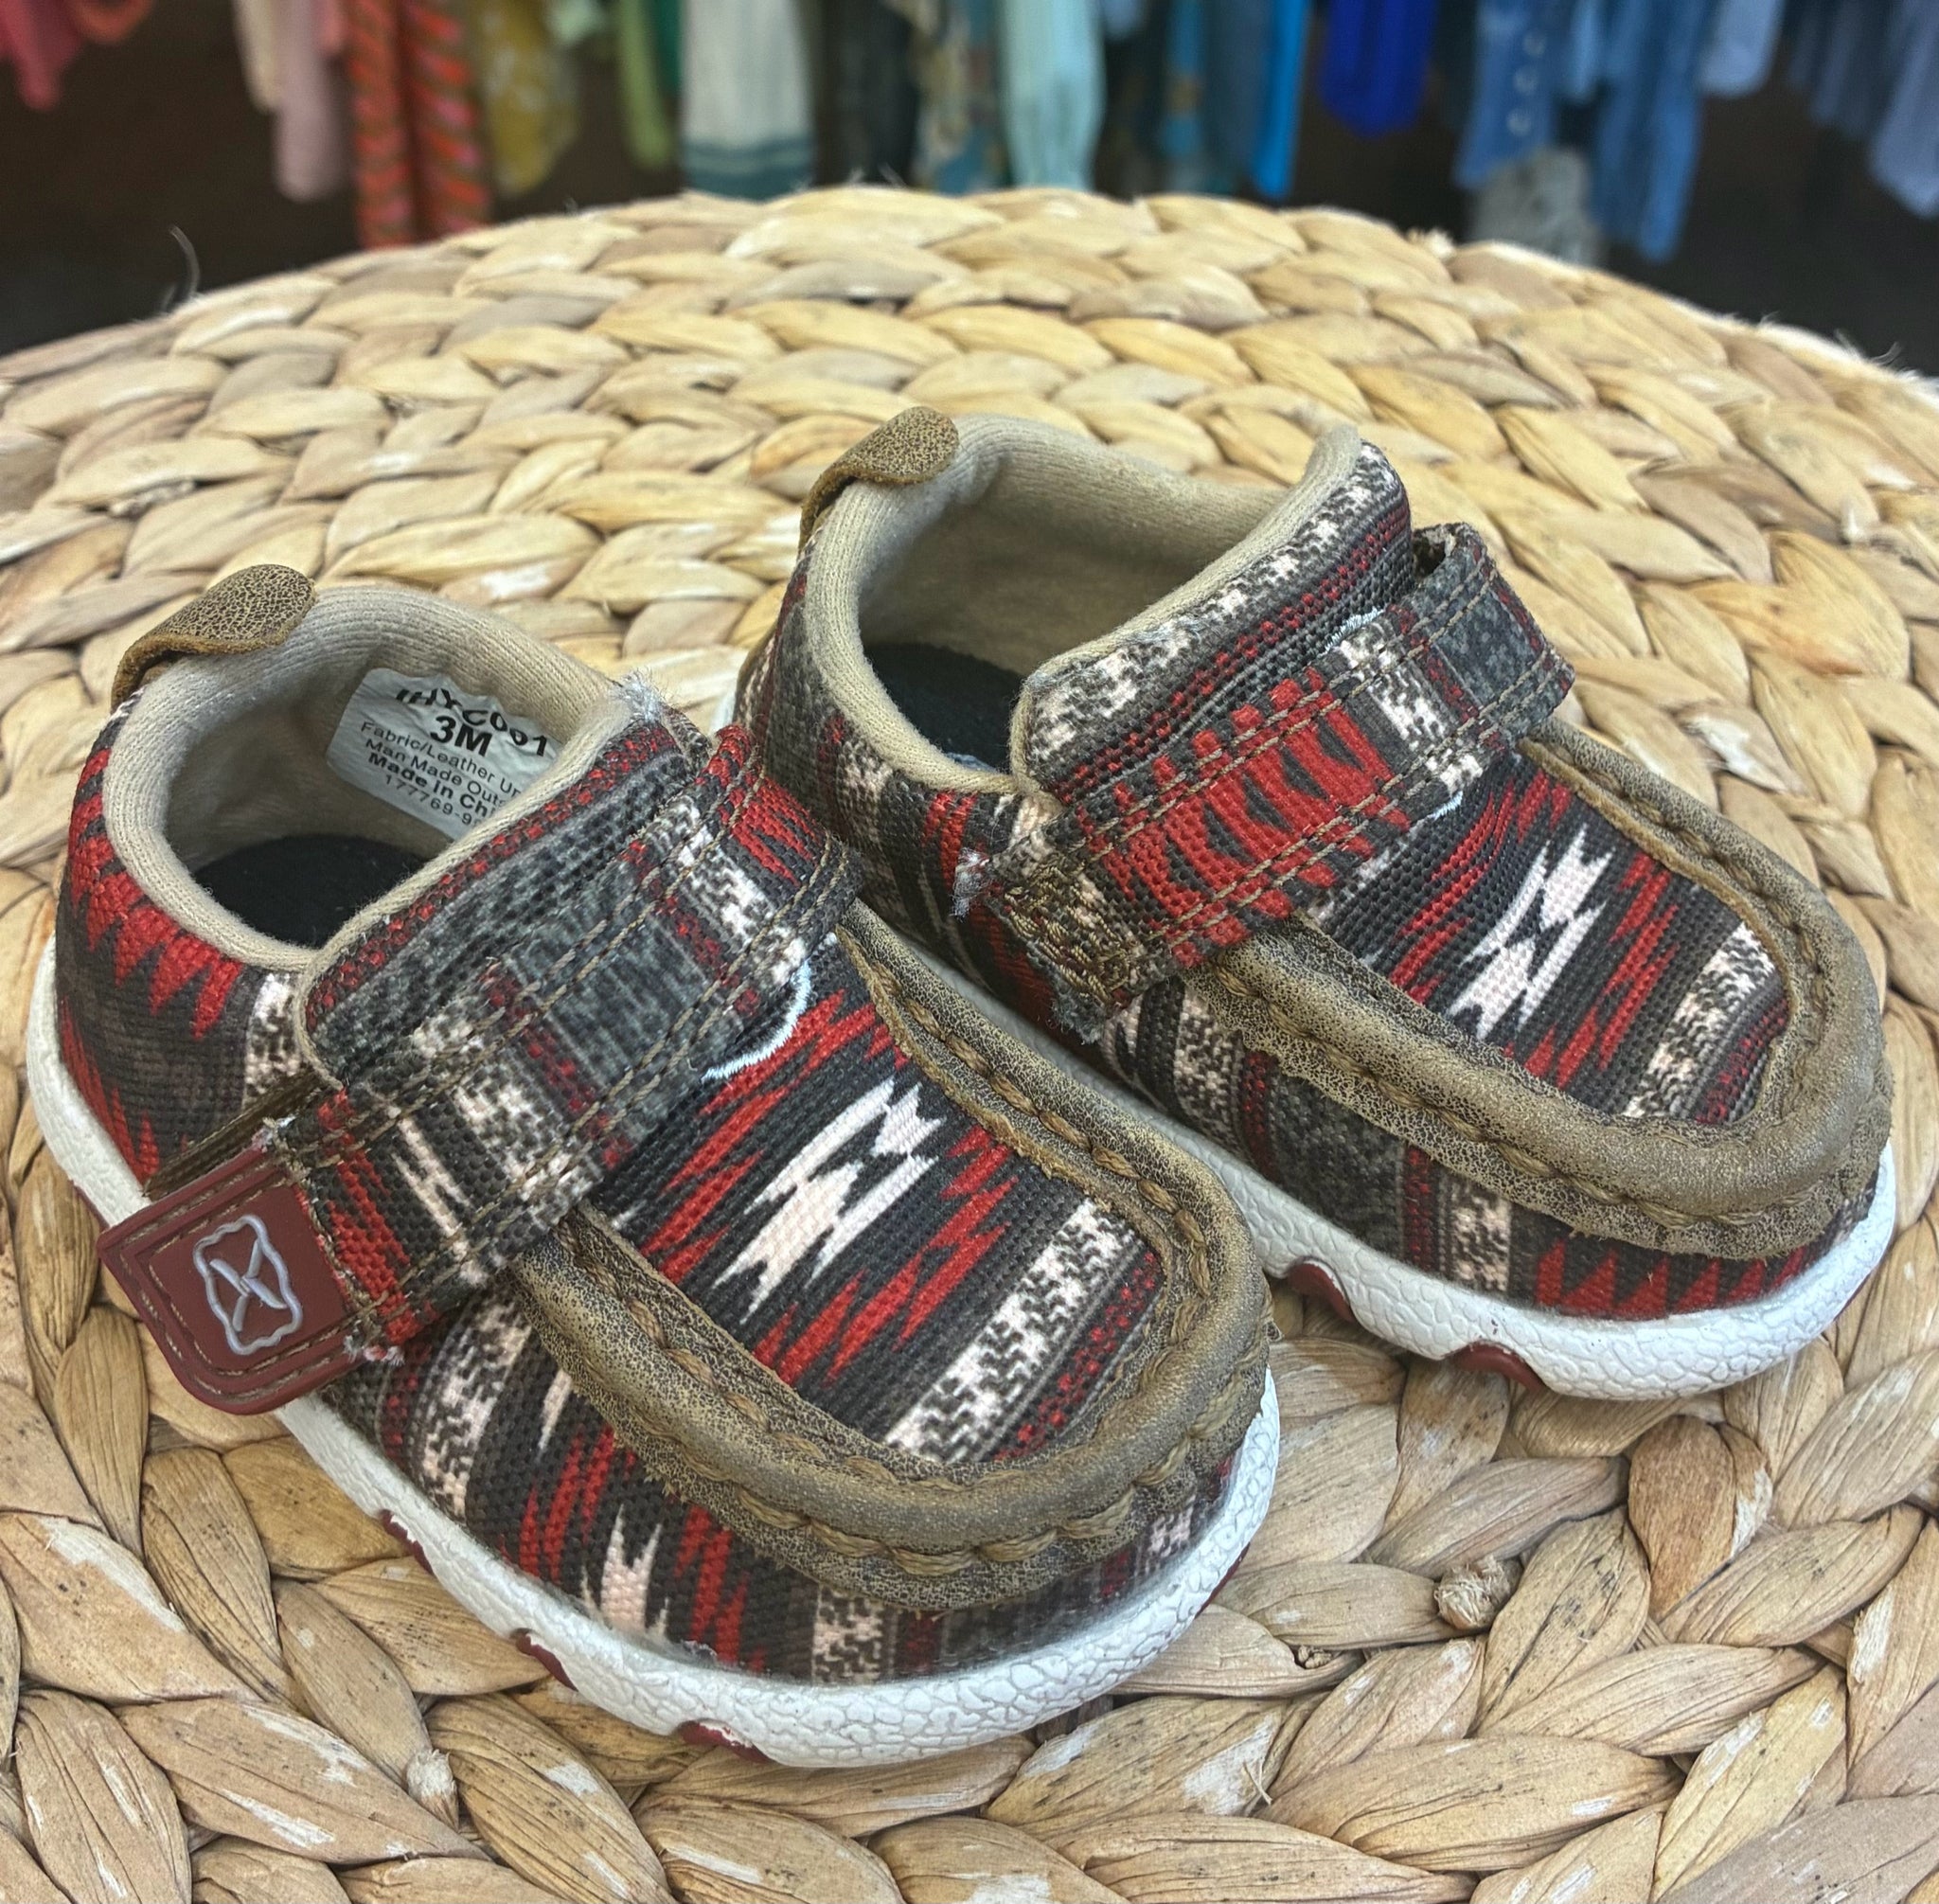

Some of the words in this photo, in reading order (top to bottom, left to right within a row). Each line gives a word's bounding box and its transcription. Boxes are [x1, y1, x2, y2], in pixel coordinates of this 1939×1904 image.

[360, 721, 495, 783] Fabric/Leather
[430, 716, 493, 756] 3M
[365, 738, 406, 762] Man
[410, 756, 463, 786] Made
[368, 753, 428, 788] Made
